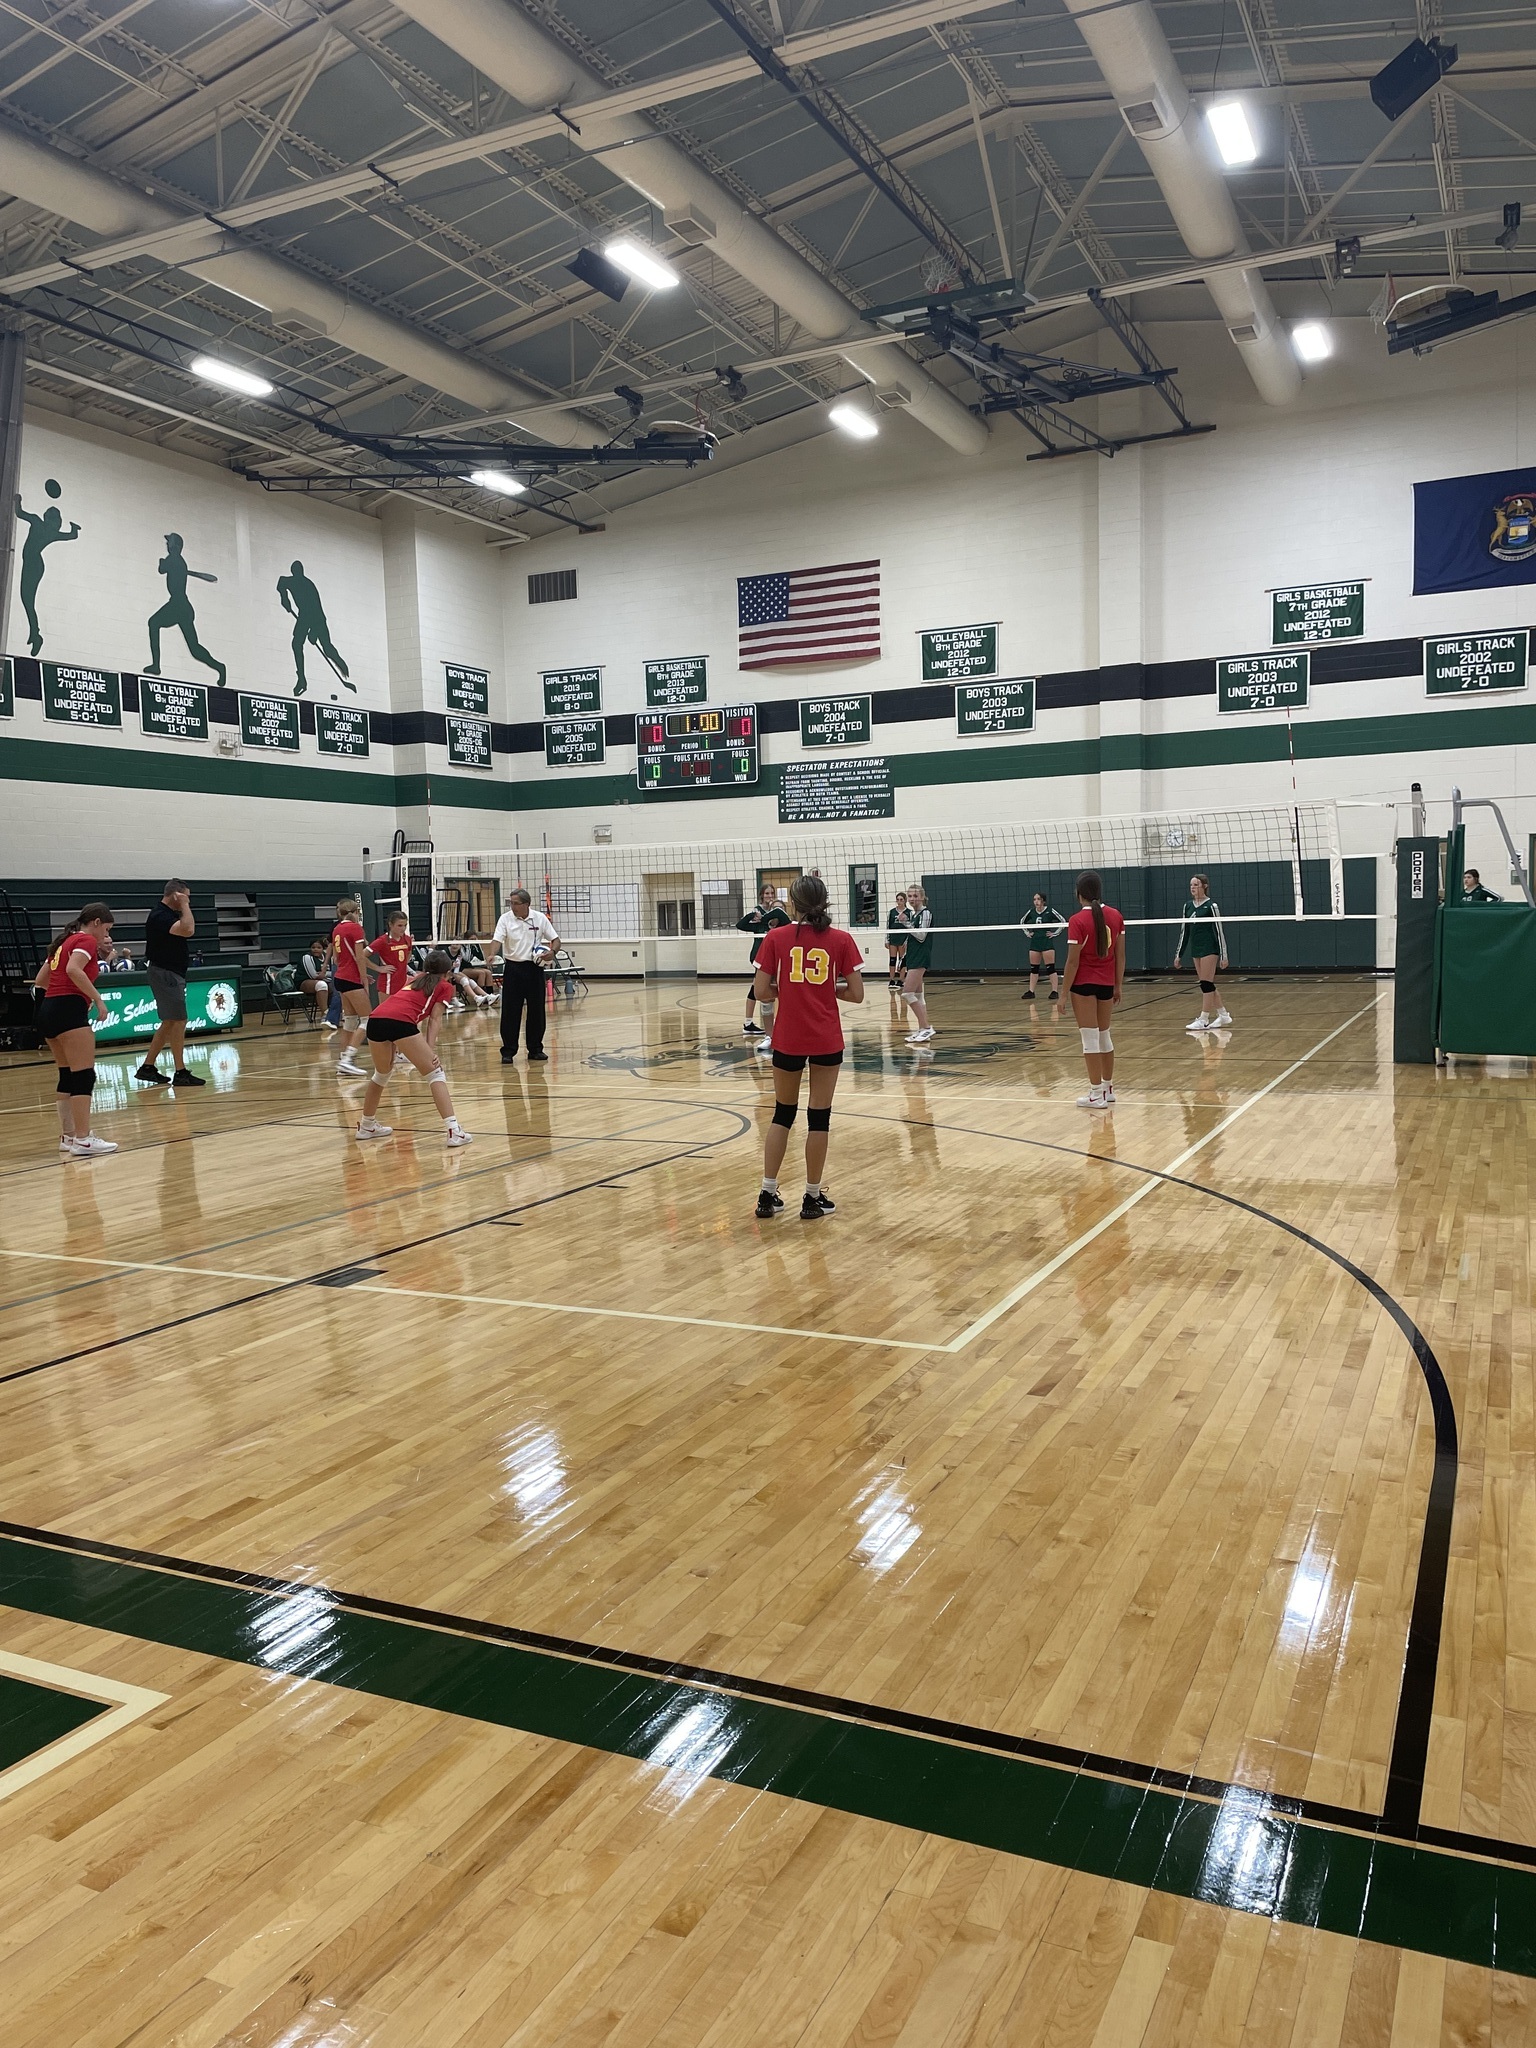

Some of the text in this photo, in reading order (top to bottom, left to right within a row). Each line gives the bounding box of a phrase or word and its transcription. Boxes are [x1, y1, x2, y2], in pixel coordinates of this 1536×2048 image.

[1276, 586, 1360, 603] GIRLS BASKETBALL
[1289, 597, 1347, 612] 7TH GRADE
[1304, 610, 1330, 620] 2012
[1284, 617, 1351, 632] UNDEFEATED
[930, 630, 987, 643] VOLLEYBALL
[1304, 629, 1331, 640] 12-0
[953, 639, 982, 650] GRADE
[1436, 637, 1515, 655] GIRLS TRACK
[948, 650, 969, 659] 2012
[1460, 651, 1492, 665] 2002
[648, 661, 703, 673] GIRLS BASKETBALL
[931, 656, 986, 669] UNDEFEATED
[1228, 657, 1298, 674] GIRLS TRACK
[57, 668, 105, 683] FOOTBALL
[671, 670, 694, 679] GRADE
[947, 667, 970, 676] 12-0
[1436, 661, 1515, 679] UNDEFEATED
[466, 673, 485, 683] TRACK
[545, 673, 597, 685] GIRLS TRACK
[667, 679, 684, 687] 2013
[1248, 672, 1278, 683] 2003
[1461, 675, 1489, 689] 7-0
[58, 678, 106, 693] 7TH GRADE
[148, 683, 198, 698] VOLLEYBALL
[563, 684, 580, 692] 2013
[654, 686, 698, 696] UNDEFEATED
[966, 684, 1023, 699] BOYS TRACK
[1228, 682, 1297, 698] UNDEFEATED
[70, 690, 96, 701] 2008
[168, 696, 194, 707] GRADE
[551, 692, 593, 702] UNDEFEATED
[667, 695, 685, 703] 12-0
[54, 698, 113, 713] UNDEFEATED
[251, 699, 287, 712] FOOTBALL
[810, 700, 860, 713] BOYS TRACK
[982, 697, 1007, 709] 2003
[1250, 696, 1274, 708] 7-0
[71, 711, 98, 722] 5-0-1
[151, 712, 200, 726] UNDEFEATED
[265, 711, 287, 720] GRADE
[323, 709, 362, 723] BOYS TRACK
[726, 708, 753, 718] VISITOR
[824, 712, 845, 722] 2004
[965, 707, 1025, 721] UNDEFEATED
[261, 719, 280, 728] 2007
[640, 715, 663, 725] HOME
[984, 720, 1005, 730] 7-0
[168, 724, 186, 734] 11-0
[249, 726, 293, 738] UNDEFEATED
[552, 723, 596, 734] GIRLS TRACK
[741, 718, 751, 735] 0
[808, 721, 862, 734] UNDEFEATED
[324, 730, 363, 743] UNDEFEATED
[565, 734, 583, 743] 2005
[653, 725, 662, 742] 0
[826, 733, 845, 743] 7-0
[337, 742, 352, 752] 7-0
[454, 743, 487, 755] UNDEFEATED
[552, 743, 596, 753] UNDEFEATED
[681, 742, 698, 750] PERIOD
[465, 753, 479, 762] 12-0
[567, 753, 583, 762] 7-0
[674, 754, 690, 762] FOULS
[732, 750, 749, 758] FOULS
[653, 765, 660, 778] 0
[741, 759, 749, 772] 0
[787, 759, 884, 772] SPECTATOR EXPECTATIONS
[850, 809, 879, 817] FANATIC
[1413, 852, 1422, 892] PORTER
[789, 946, 830, 985] 13
[186, 1017, 206, 1031] agles
